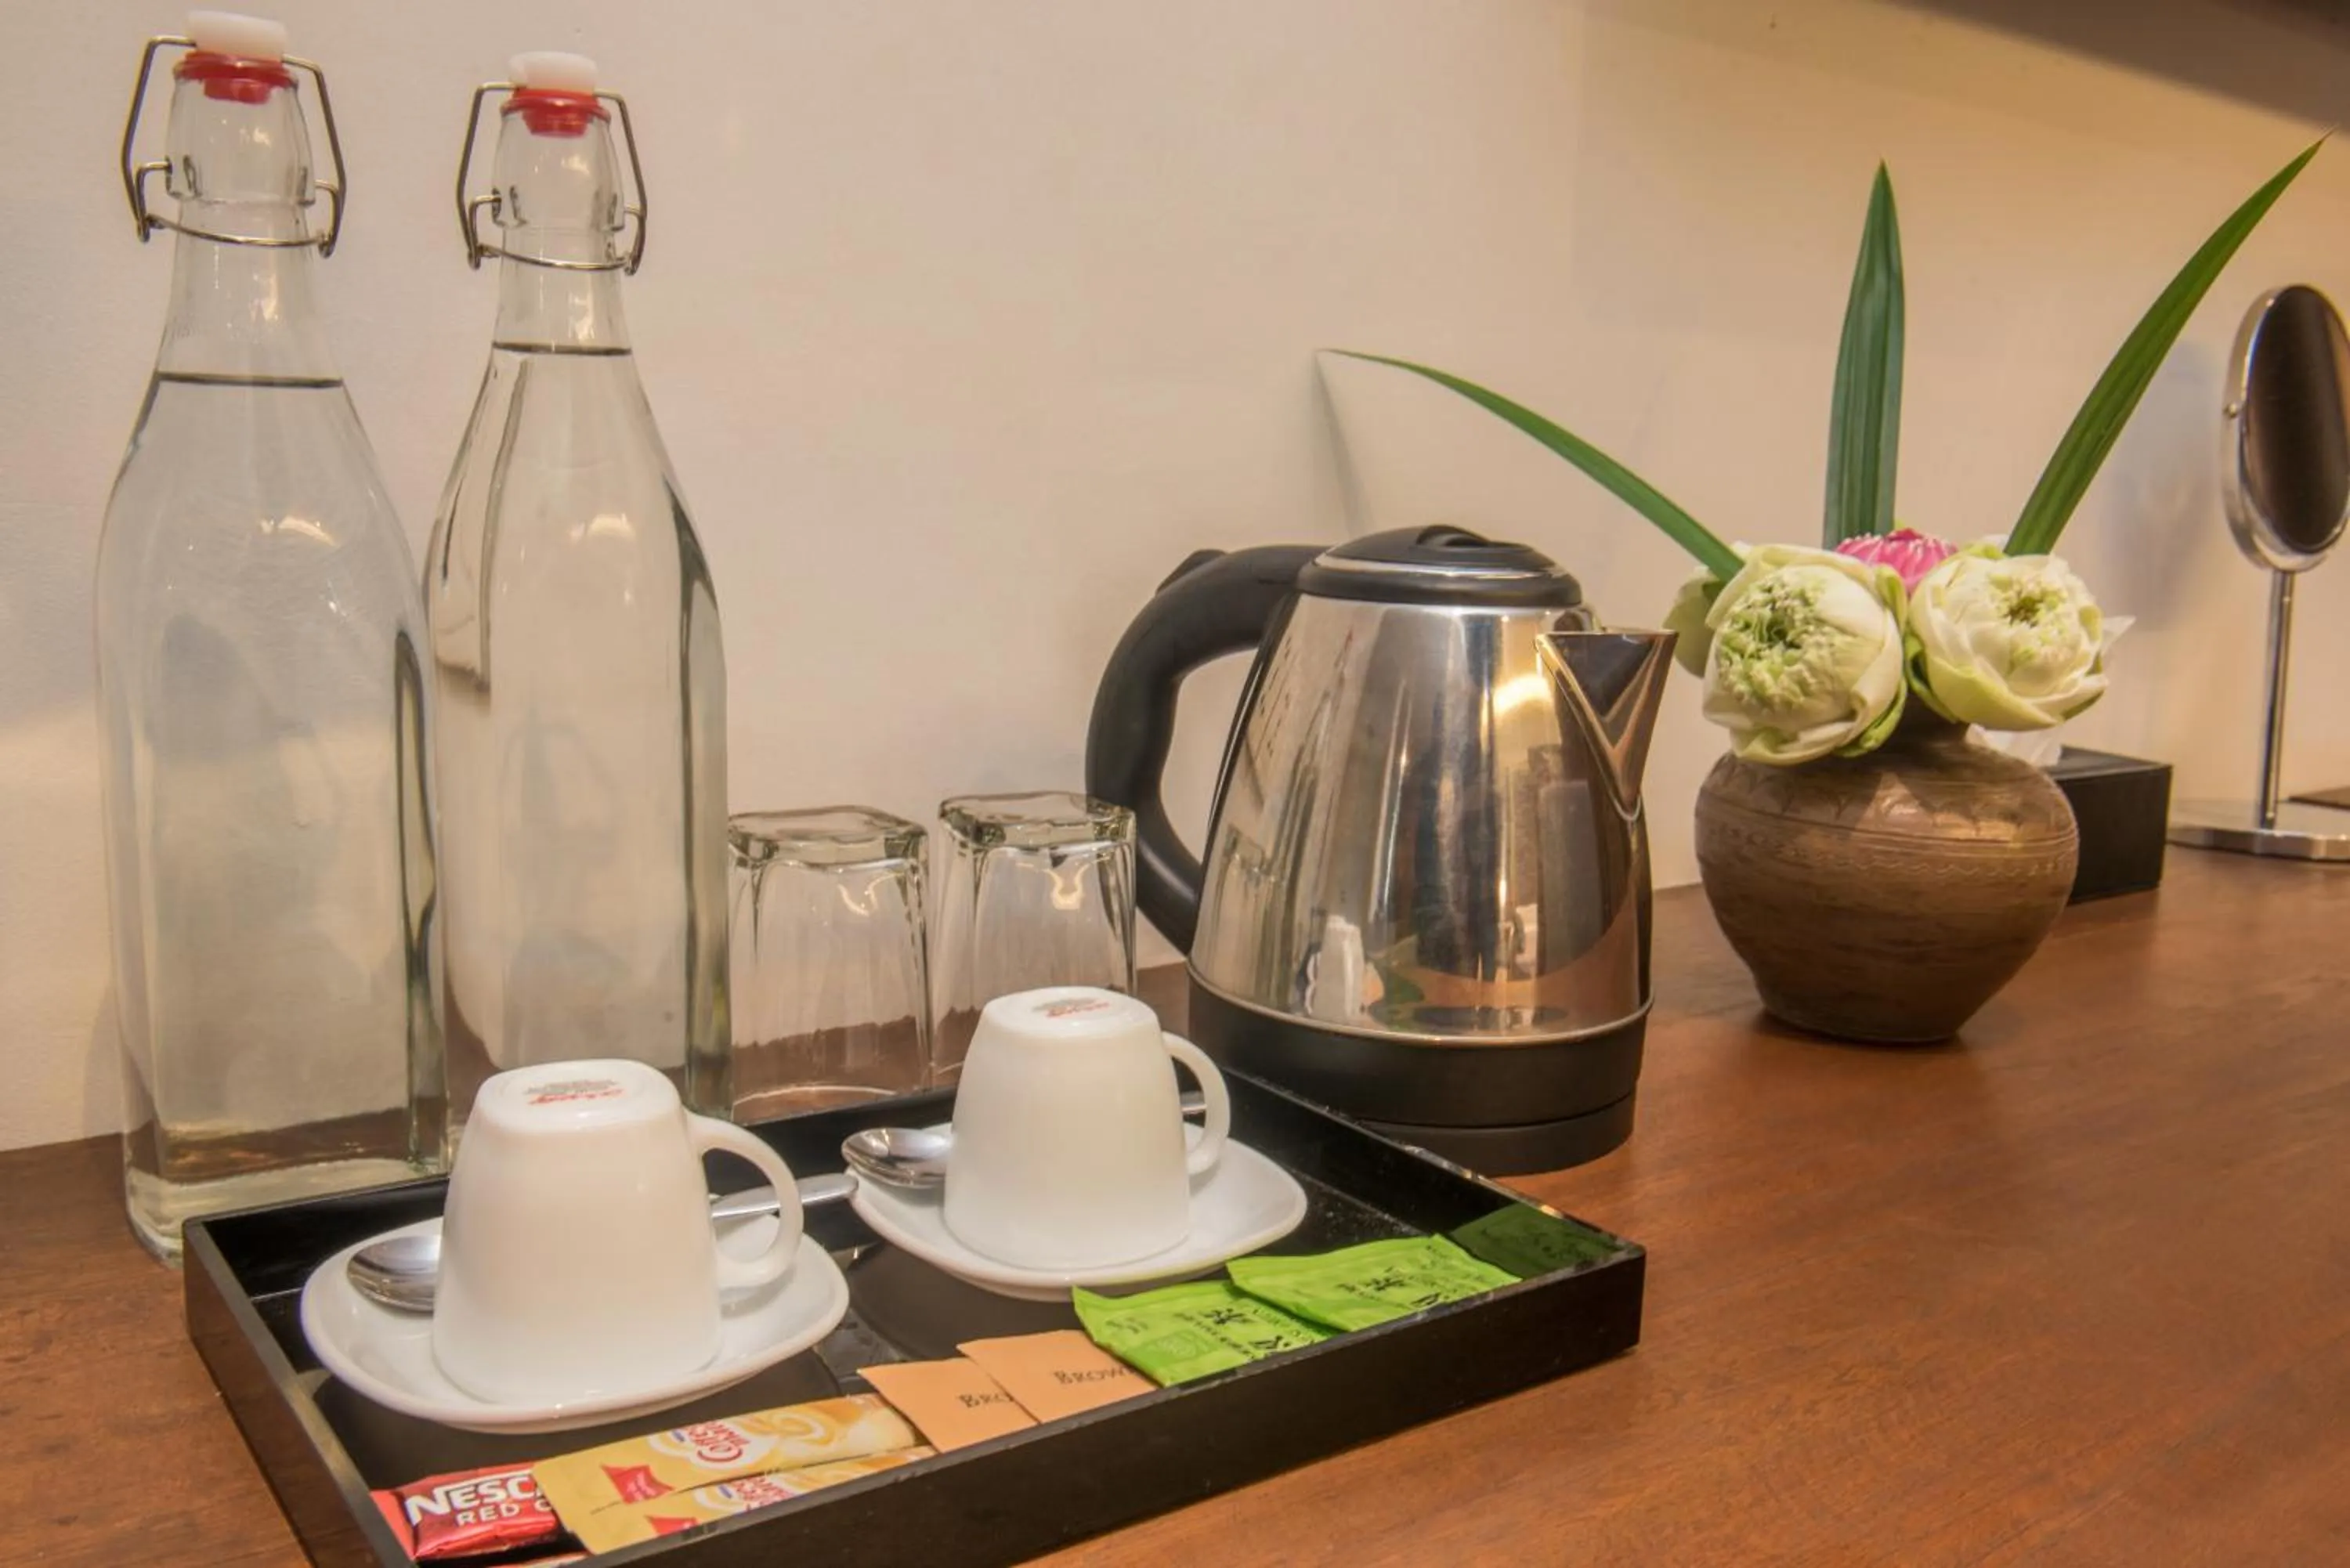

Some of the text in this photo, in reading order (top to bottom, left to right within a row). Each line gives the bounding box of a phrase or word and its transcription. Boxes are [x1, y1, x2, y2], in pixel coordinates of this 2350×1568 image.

[1054, 1366, 1136, 1385] BROW
[404, 1469, 543, 1526] NESC
[456, 1502, 520, 1526] RED
